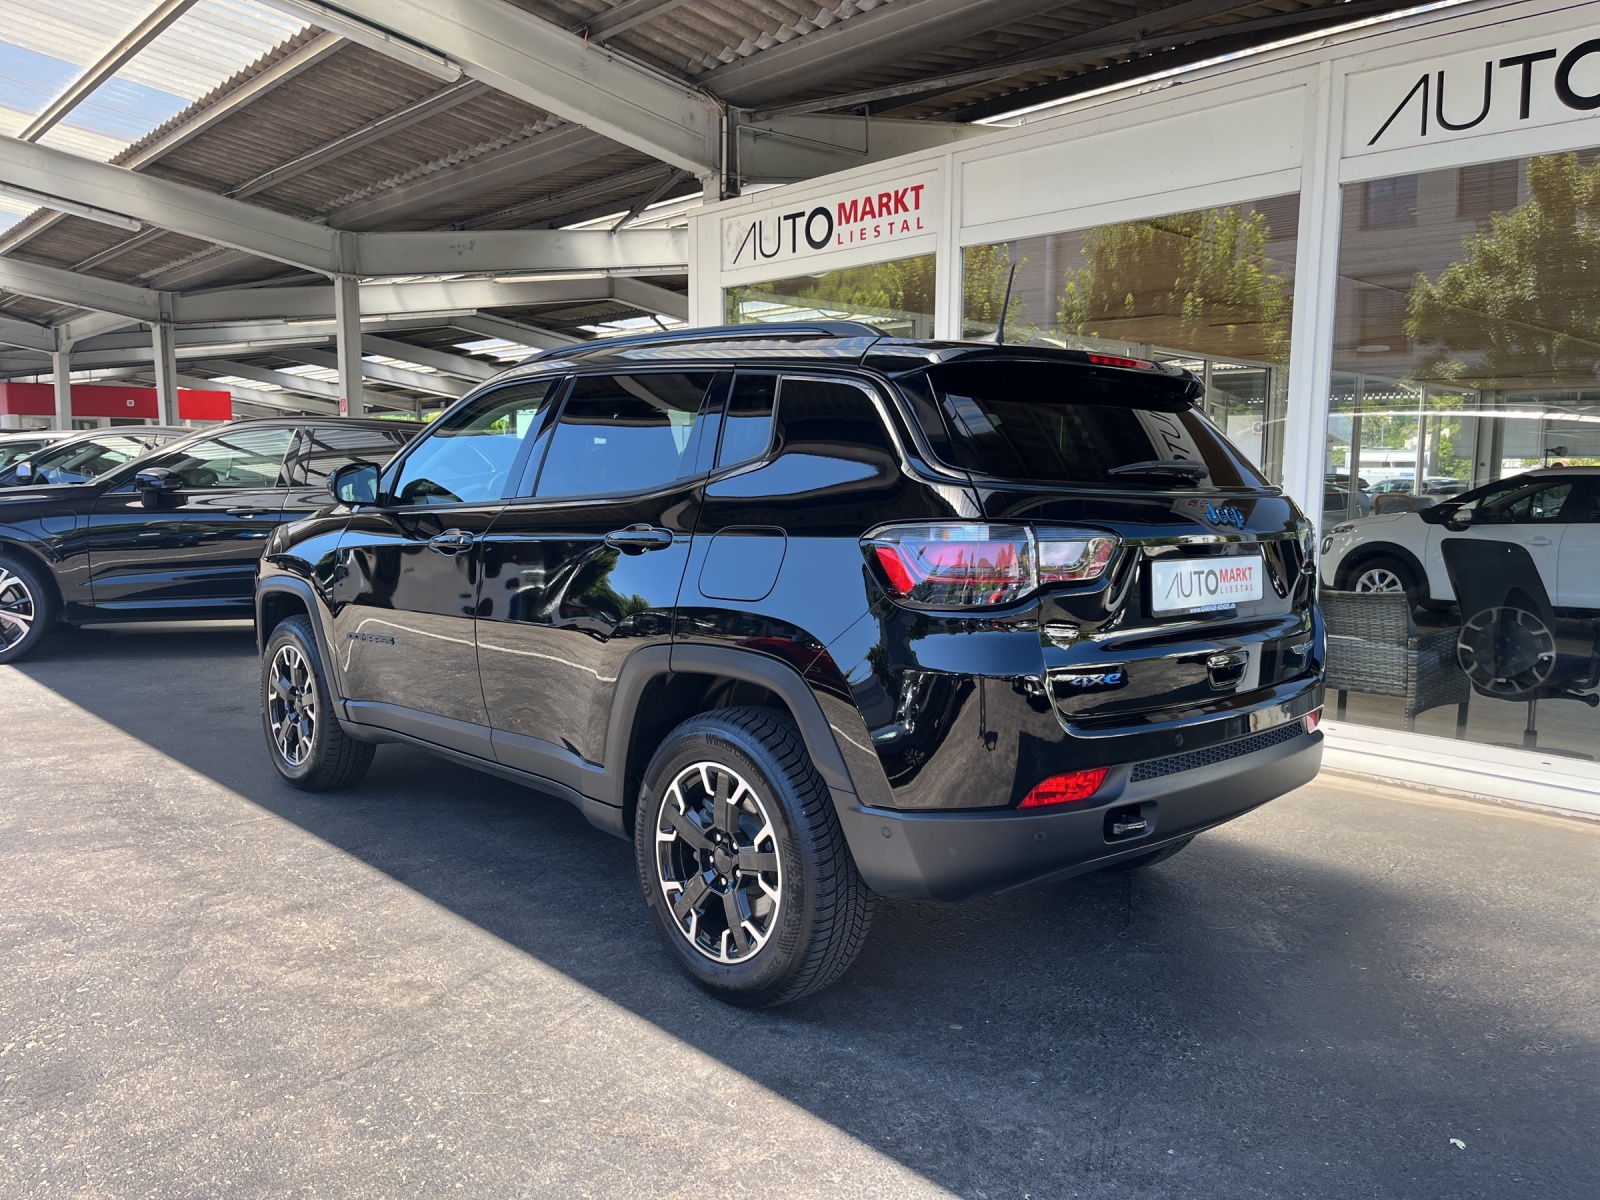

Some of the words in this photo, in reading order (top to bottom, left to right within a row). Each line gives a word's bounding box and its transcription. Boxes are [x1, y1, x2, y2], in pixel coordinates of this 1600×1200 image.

[732, 206, 834, 265] AUTO
[837, 184, 925, 227] MARKT
[837, 216, 924, 246] LIESTAL
[1205, 502, 1245, 530] Jeep
[1165, 568, 1218, 600] AUTO
[1219, 566, 1253, 583] MARKT
[1219, 584, 1254, 595] LIESTAL
